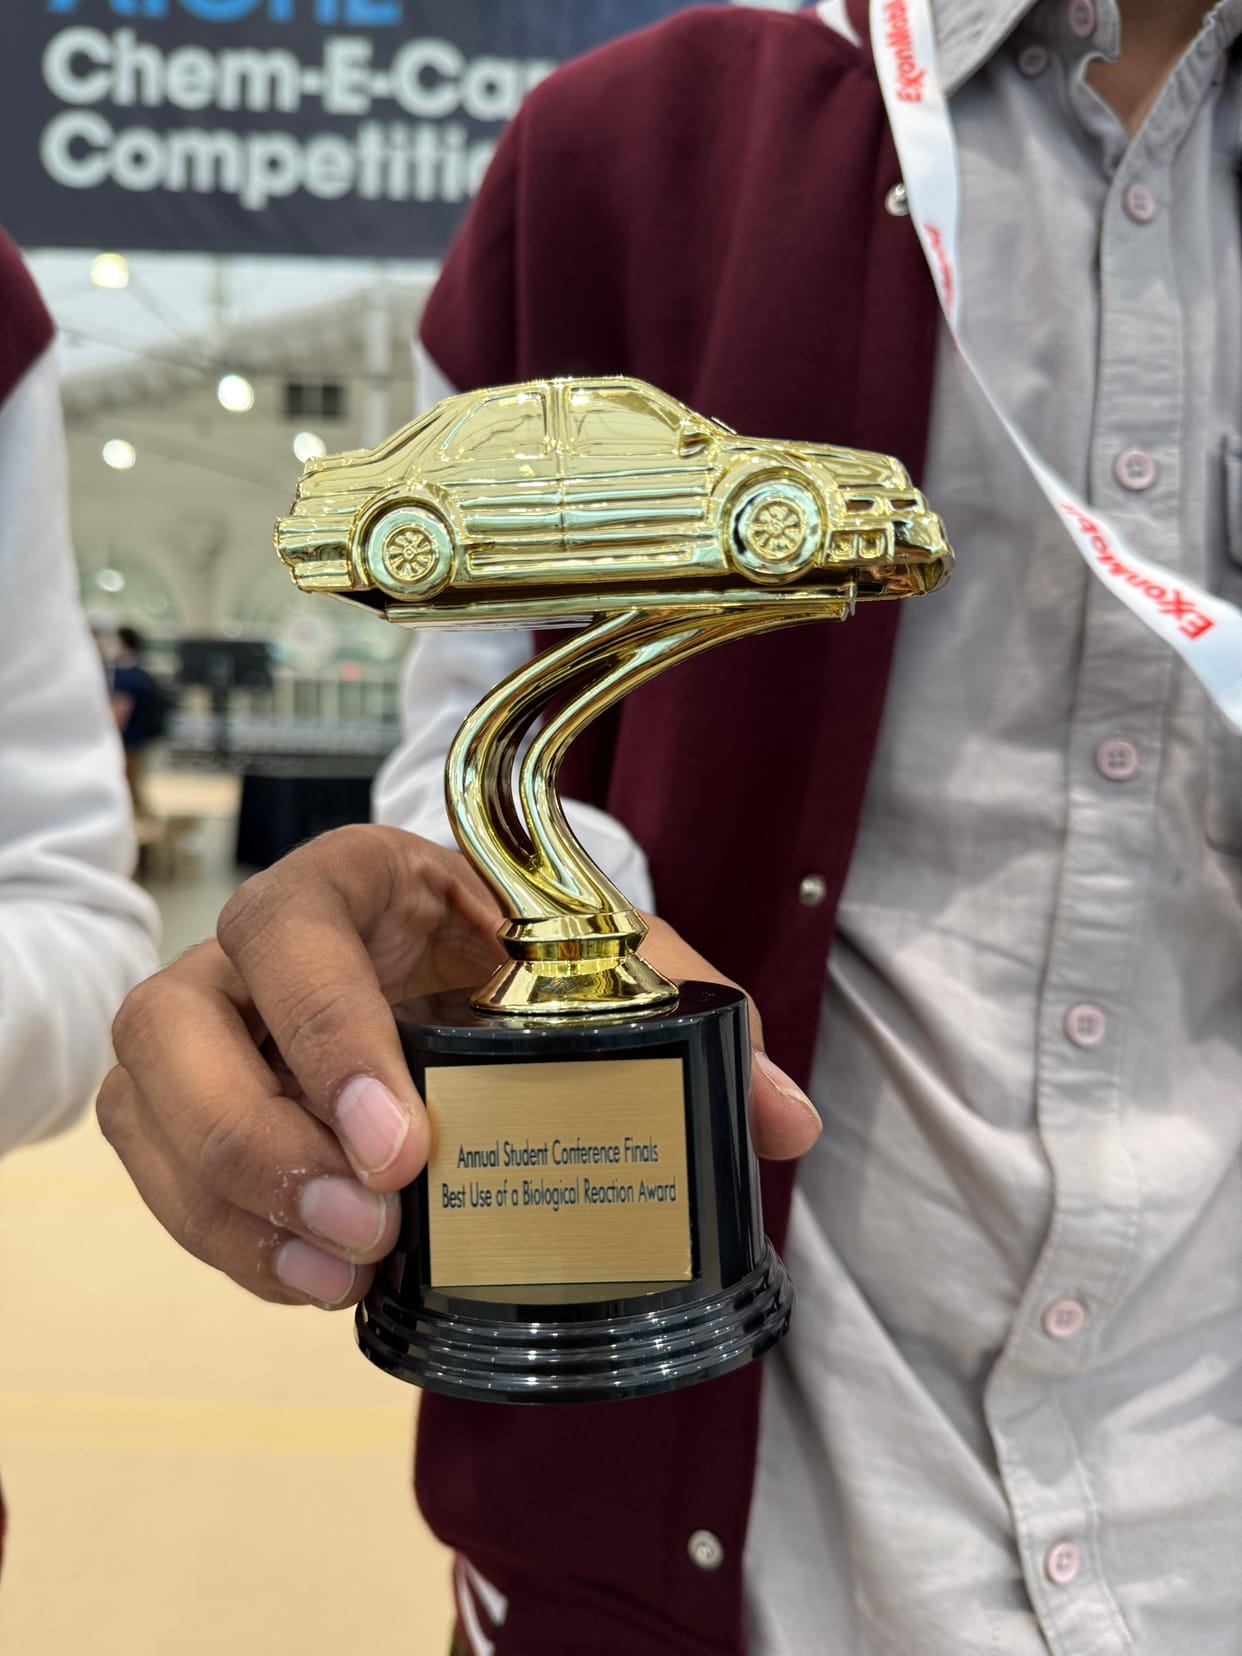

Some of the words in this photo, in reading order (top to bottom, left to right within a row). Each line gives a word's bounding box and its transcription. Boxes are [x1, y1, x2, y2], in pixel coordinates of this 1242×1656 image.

[457, 1140, 500, 1169] Annual
[503, 1138, 548, 1167] Student
[552, 1137, 621, 1166] Conference
[624, 1136, 659, 1163] Finals
[441, 1182, 466, 1209] Best
[469, 1181, 492, 1208] Use
[496, 1179, 508, 1207] of
[511, 1189, 519, 1206] a
[522, 1177, 580, 1212] Biological
[583, 1176, 634, 1204] Reaction
[638, 1175, 677, 1202] Award
